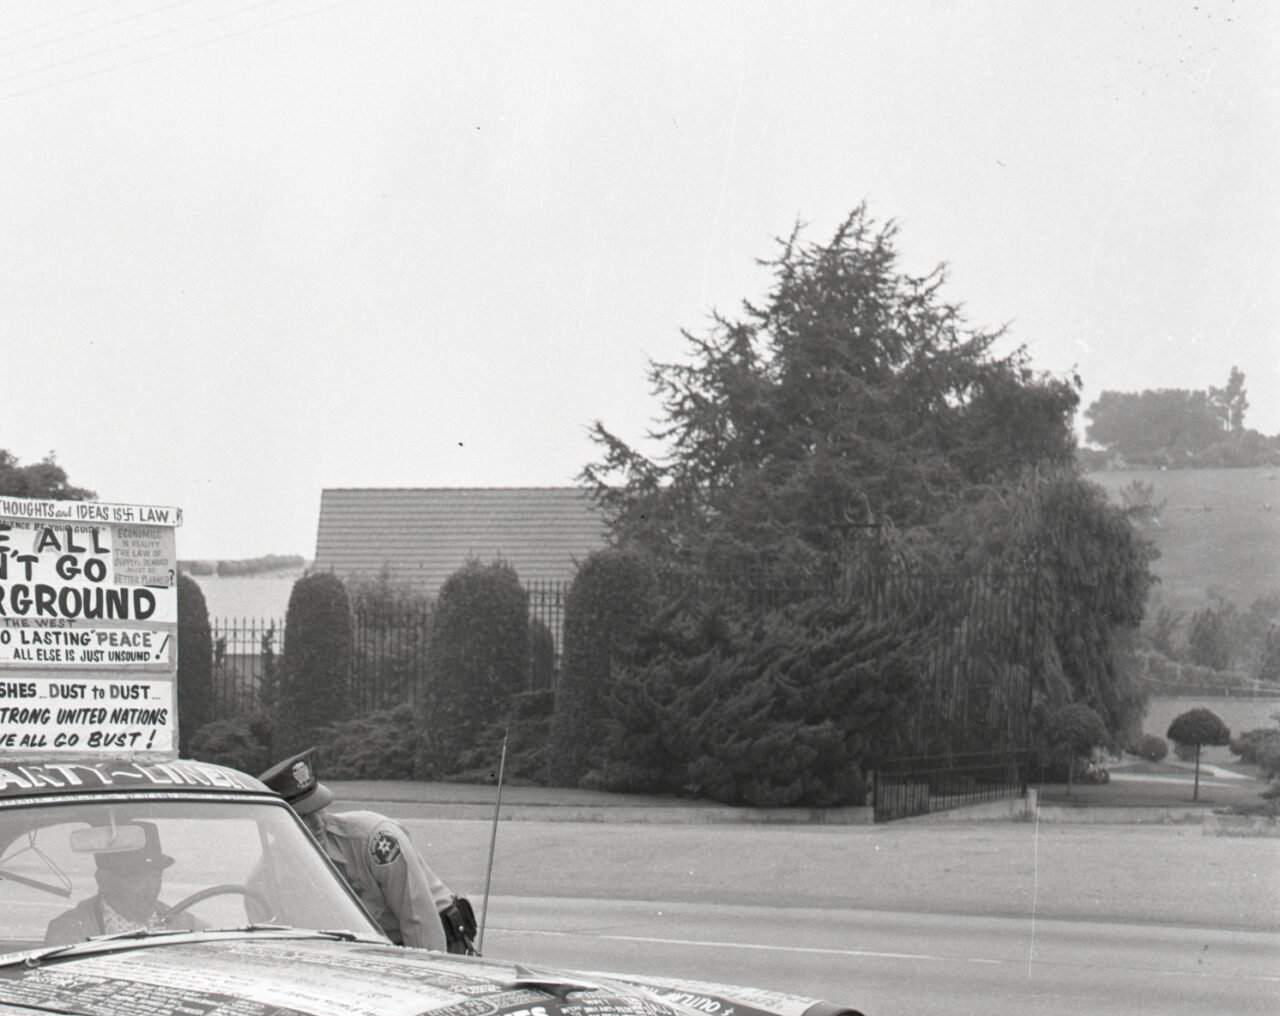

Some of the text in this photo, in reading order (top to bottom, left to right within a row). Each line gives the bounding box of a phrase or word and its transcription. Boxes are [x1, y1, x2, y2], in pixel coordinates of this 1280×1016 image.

[56, 507, 71, 518] and
[77, 505, 109, 520] IDEAS
[114, 509, 122, 521] IS
[38, 526, 110, 553] ALL
[56, 555, 107, 583] GO
[4, 618, 30, 627] THE
[36, 619, 76, 627] WEST
[21, 630, 91, 646] LASTING
[13, 648, 33, 660] ALL
[37, 649, 61, 661] ELSE
[66, 650, 74, 661] IS
[80, 650, 104, 662] JUST
[109, 651, 150, 661] UNSOUND
[49, 684, 86, 699] DUST
[92, 686, 105, 699] to
[57, 708, 107, 724] UNITED
[110, 708, 168, 725] NATIONS
[20, 734, 47, 747] ALL
[54, 733, 79, 747] GO
